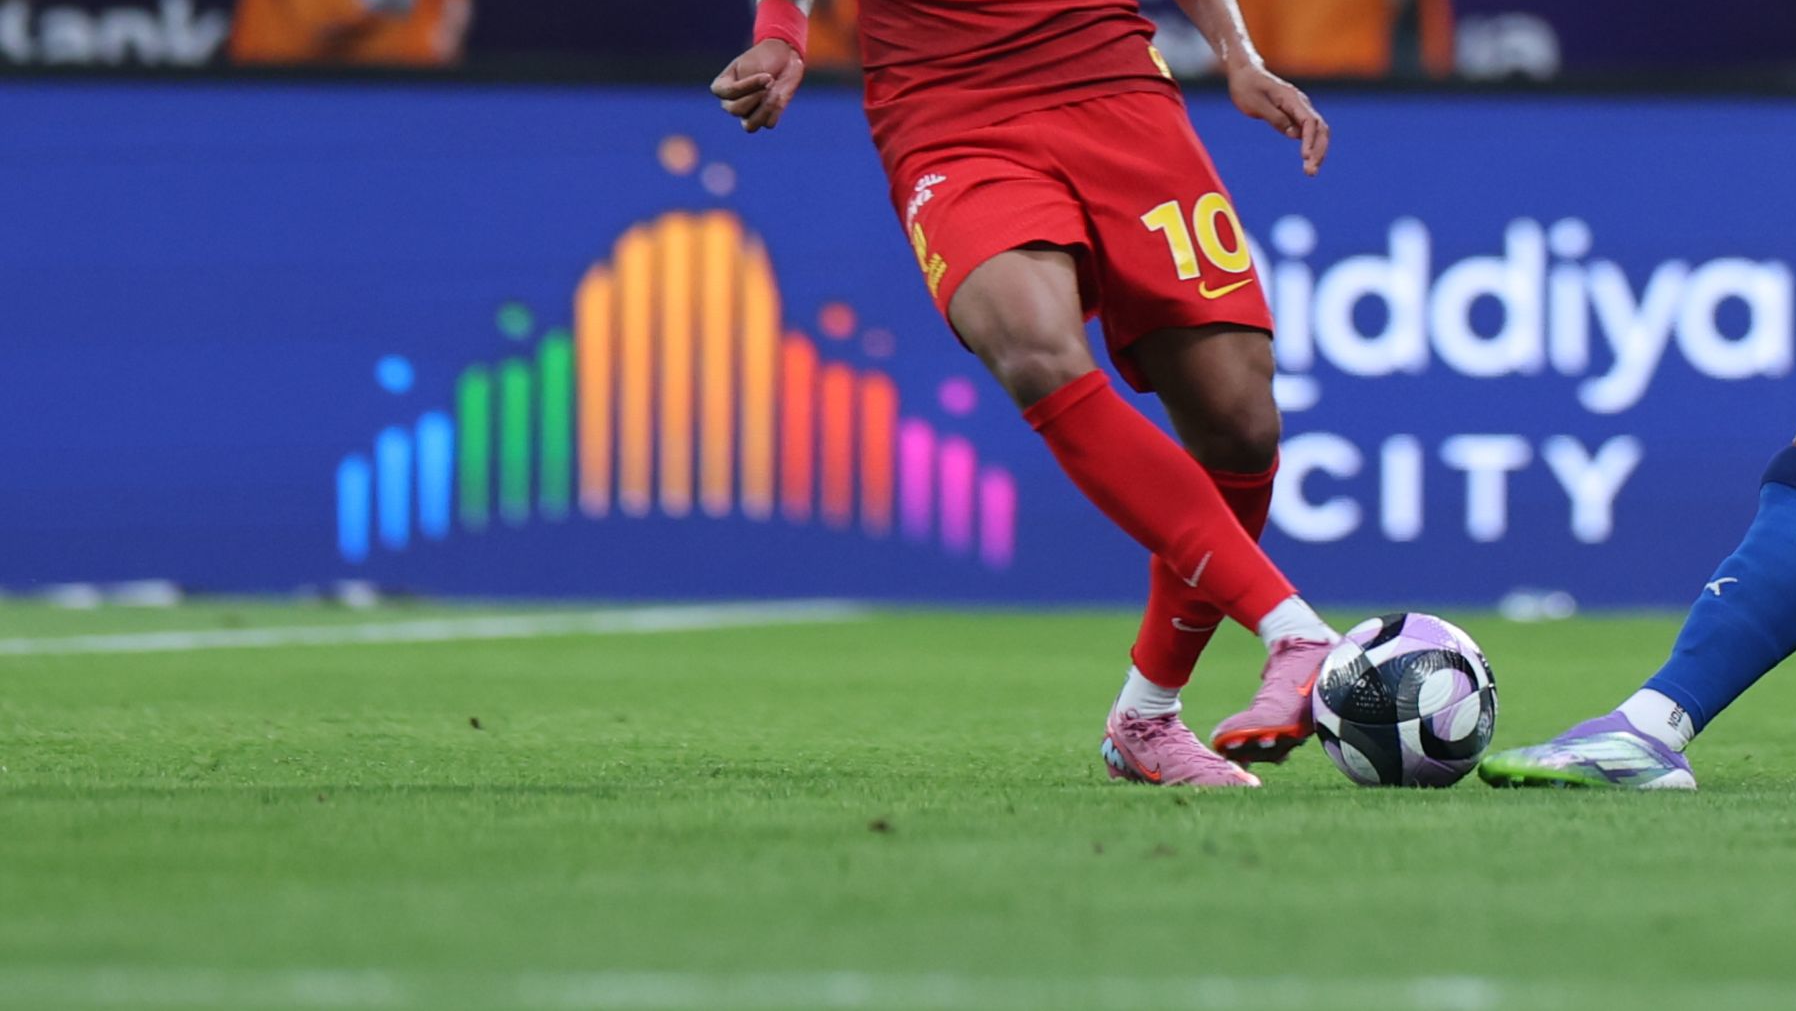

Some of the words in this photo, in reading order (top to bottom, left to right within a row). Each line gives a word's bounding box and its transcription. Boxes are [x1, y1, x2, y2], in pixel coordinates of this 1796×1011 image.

[1140, 193, 1252, 280] 10
[1250, 218, 1796, 415] iddiya
[1268, 432, 1642, 544] CITY
